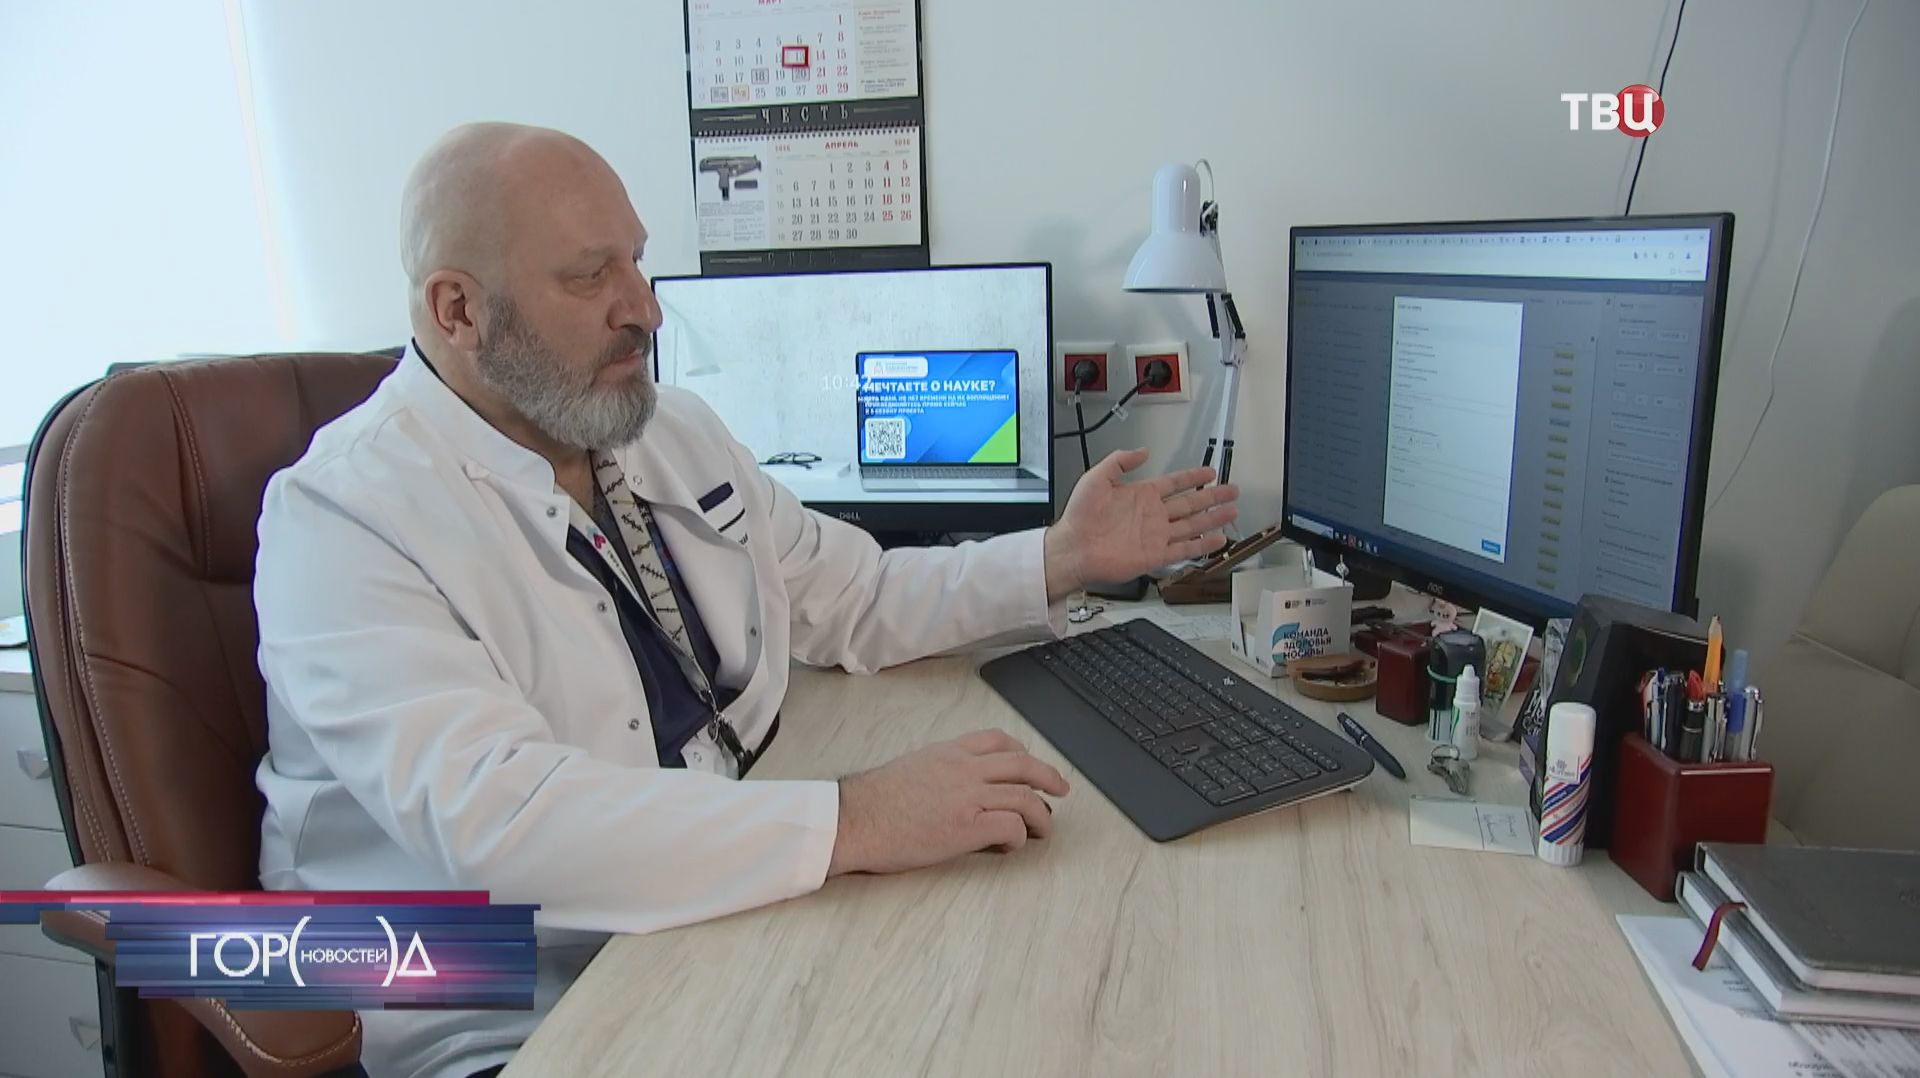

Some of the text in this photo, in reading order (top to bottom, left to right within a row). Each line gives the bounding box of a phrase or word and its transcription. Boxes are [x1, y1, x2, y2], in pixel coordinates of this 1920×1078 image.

[761, 104, 849, 124] ЧЕСТЬ
[825, 140, 859, 150] АПРЕЛЬ
[829, 162, 834, 174] 1
[846, 161, 853, 173] 2
[865, 161, 872, 172] 3
[883, 160, 890, 171] 4
[902, 159, 908, 171] 5
[793, 180, 799, 192] 6
[811, 180, 817, 191] 7
[829, 179, 836, 190] 8
[847, 178, 854, 189] 9
[864, 177, 874, 189] 10
[883, 177, 892, 188] 11
[900, 176, 911, 188] 12
[792, 197, 802, 209] 13
[809, 196, 820, 208] 14
[828, 195, 838, 207] 15
[846, 194, 856, 206] 16
[864, 193, 874, 205] 17
[882, 193, 893, 205] 18
[901, 192, 911, 204] 19
[791, 214, 803, 225] 20
[810, 213, 820, 225] 21
[828, 212, 839, 224] 22
[846, 212, 857, 223] 23
[864, 211, 875, 222] 24
[882, 210, 894, 222] 25
[900, 209, 912, 221] 26
[792, 230, 804, 241] 27
[810, 229, 822, 241] 28
[828, 228, 840, 240] 29
[846, 227, 858, 240] 30
[864, 380, 996, 393] МЕЧТАЕТЕ О НАУКЕ?
[839, 511, 861, 521] DELL
[1283, 627, 1329, 640] КОМАНДА
[1283, 636, 1332, 650] ЗДОРОВЬЯ
